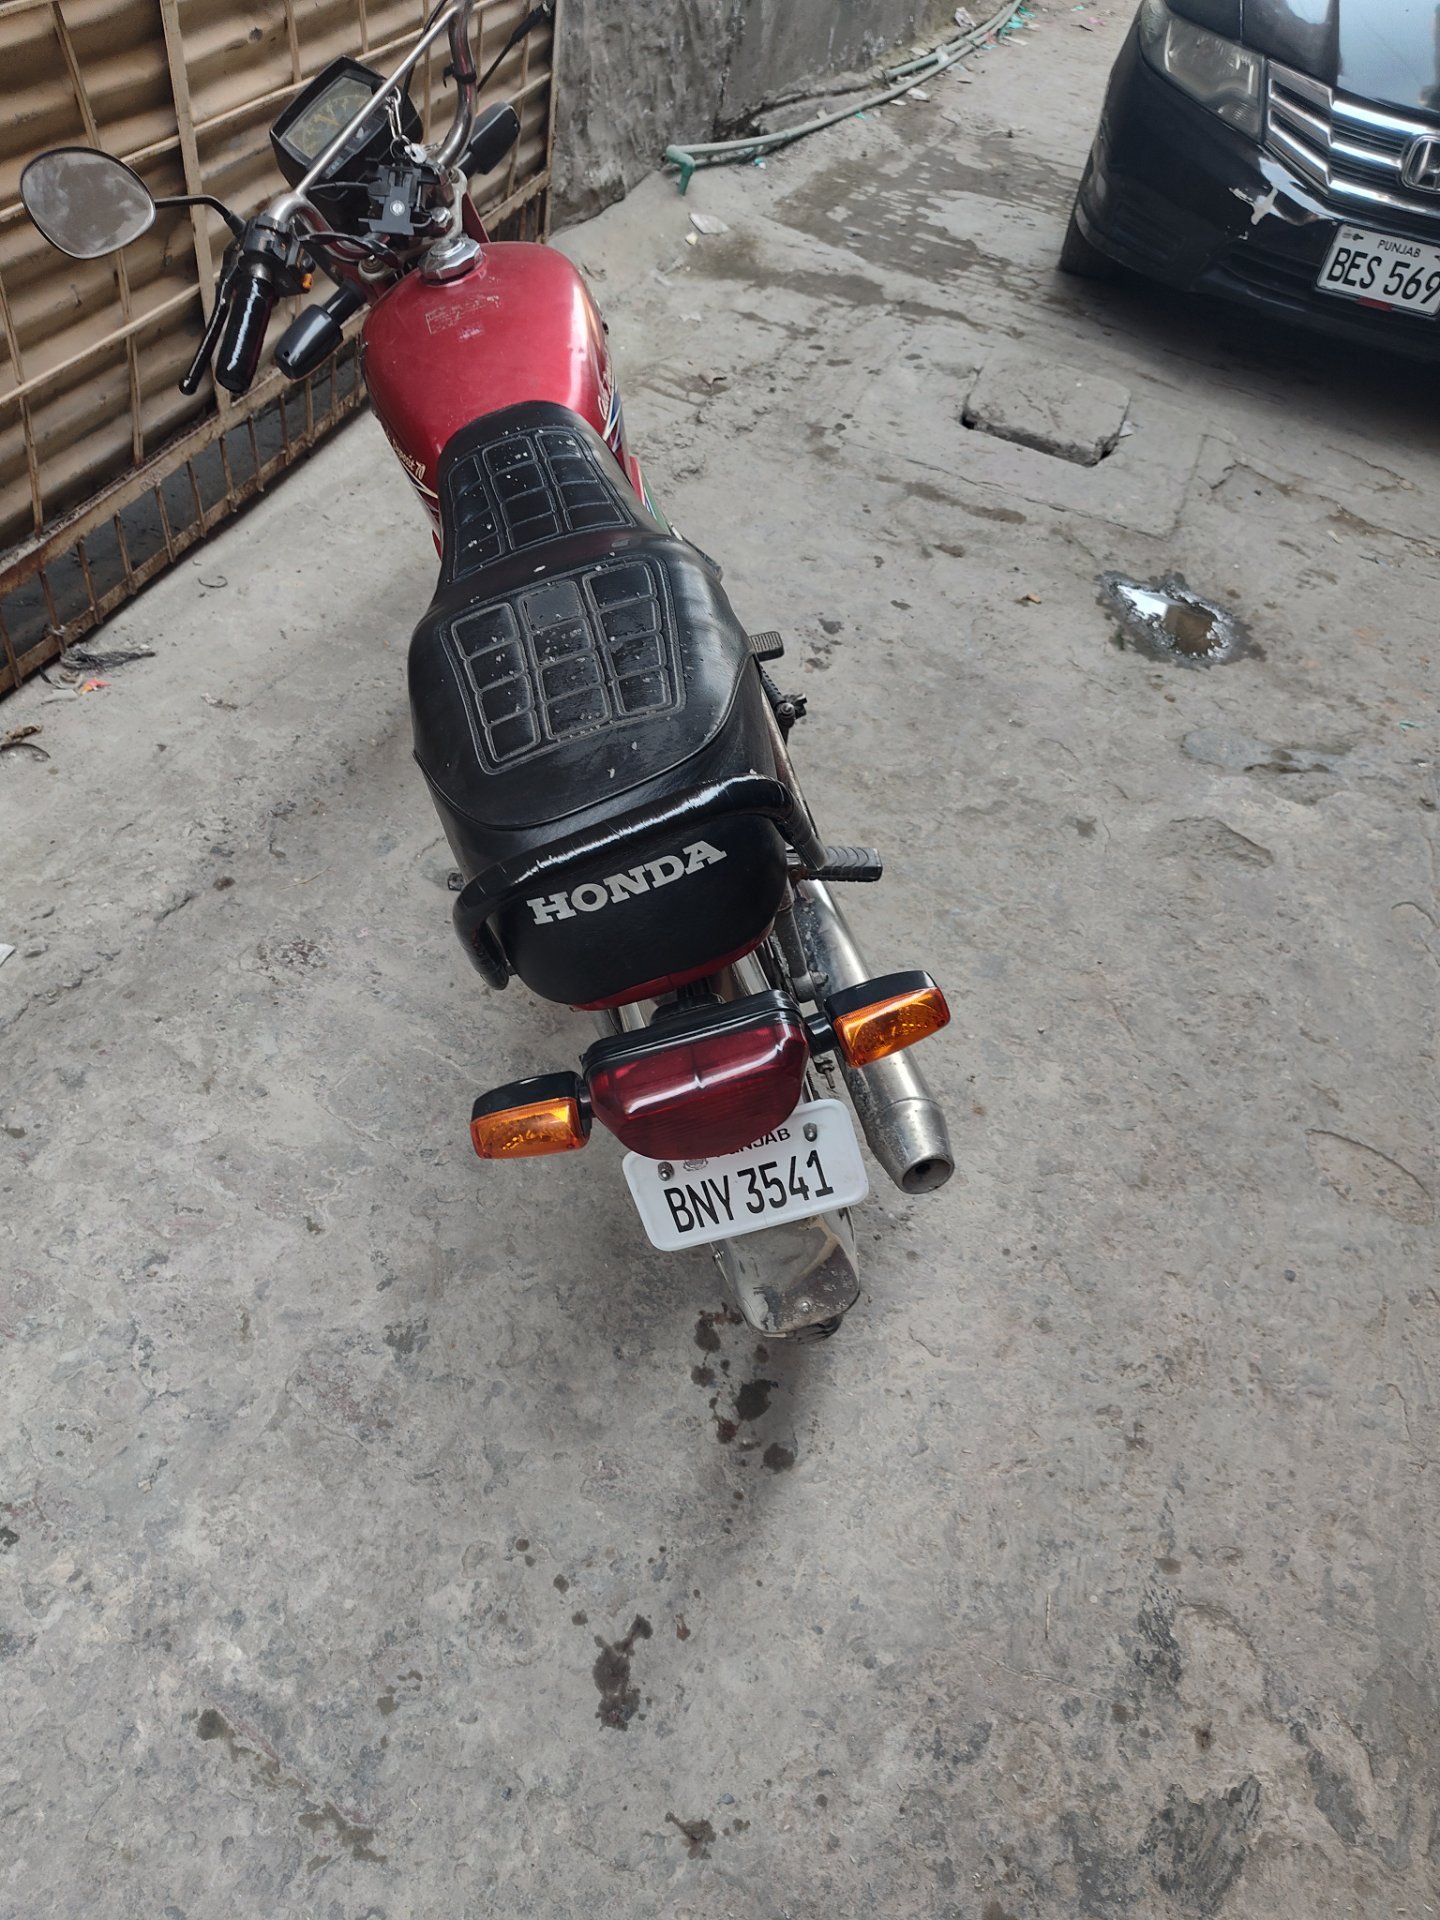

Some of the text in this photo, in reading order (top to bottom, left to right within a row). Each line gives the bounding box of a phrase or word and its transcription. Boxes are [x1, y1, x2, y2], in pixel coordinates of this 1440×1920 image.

[1327, 247, 1440, 304] BES 569
[1377, 239, 1422, 258] PUNJAB
[526, 840, 728, 925] HONDA
[716, 1127, 791, 1158] JAB
[663, 1149, 834, 1233] BNY 3541
